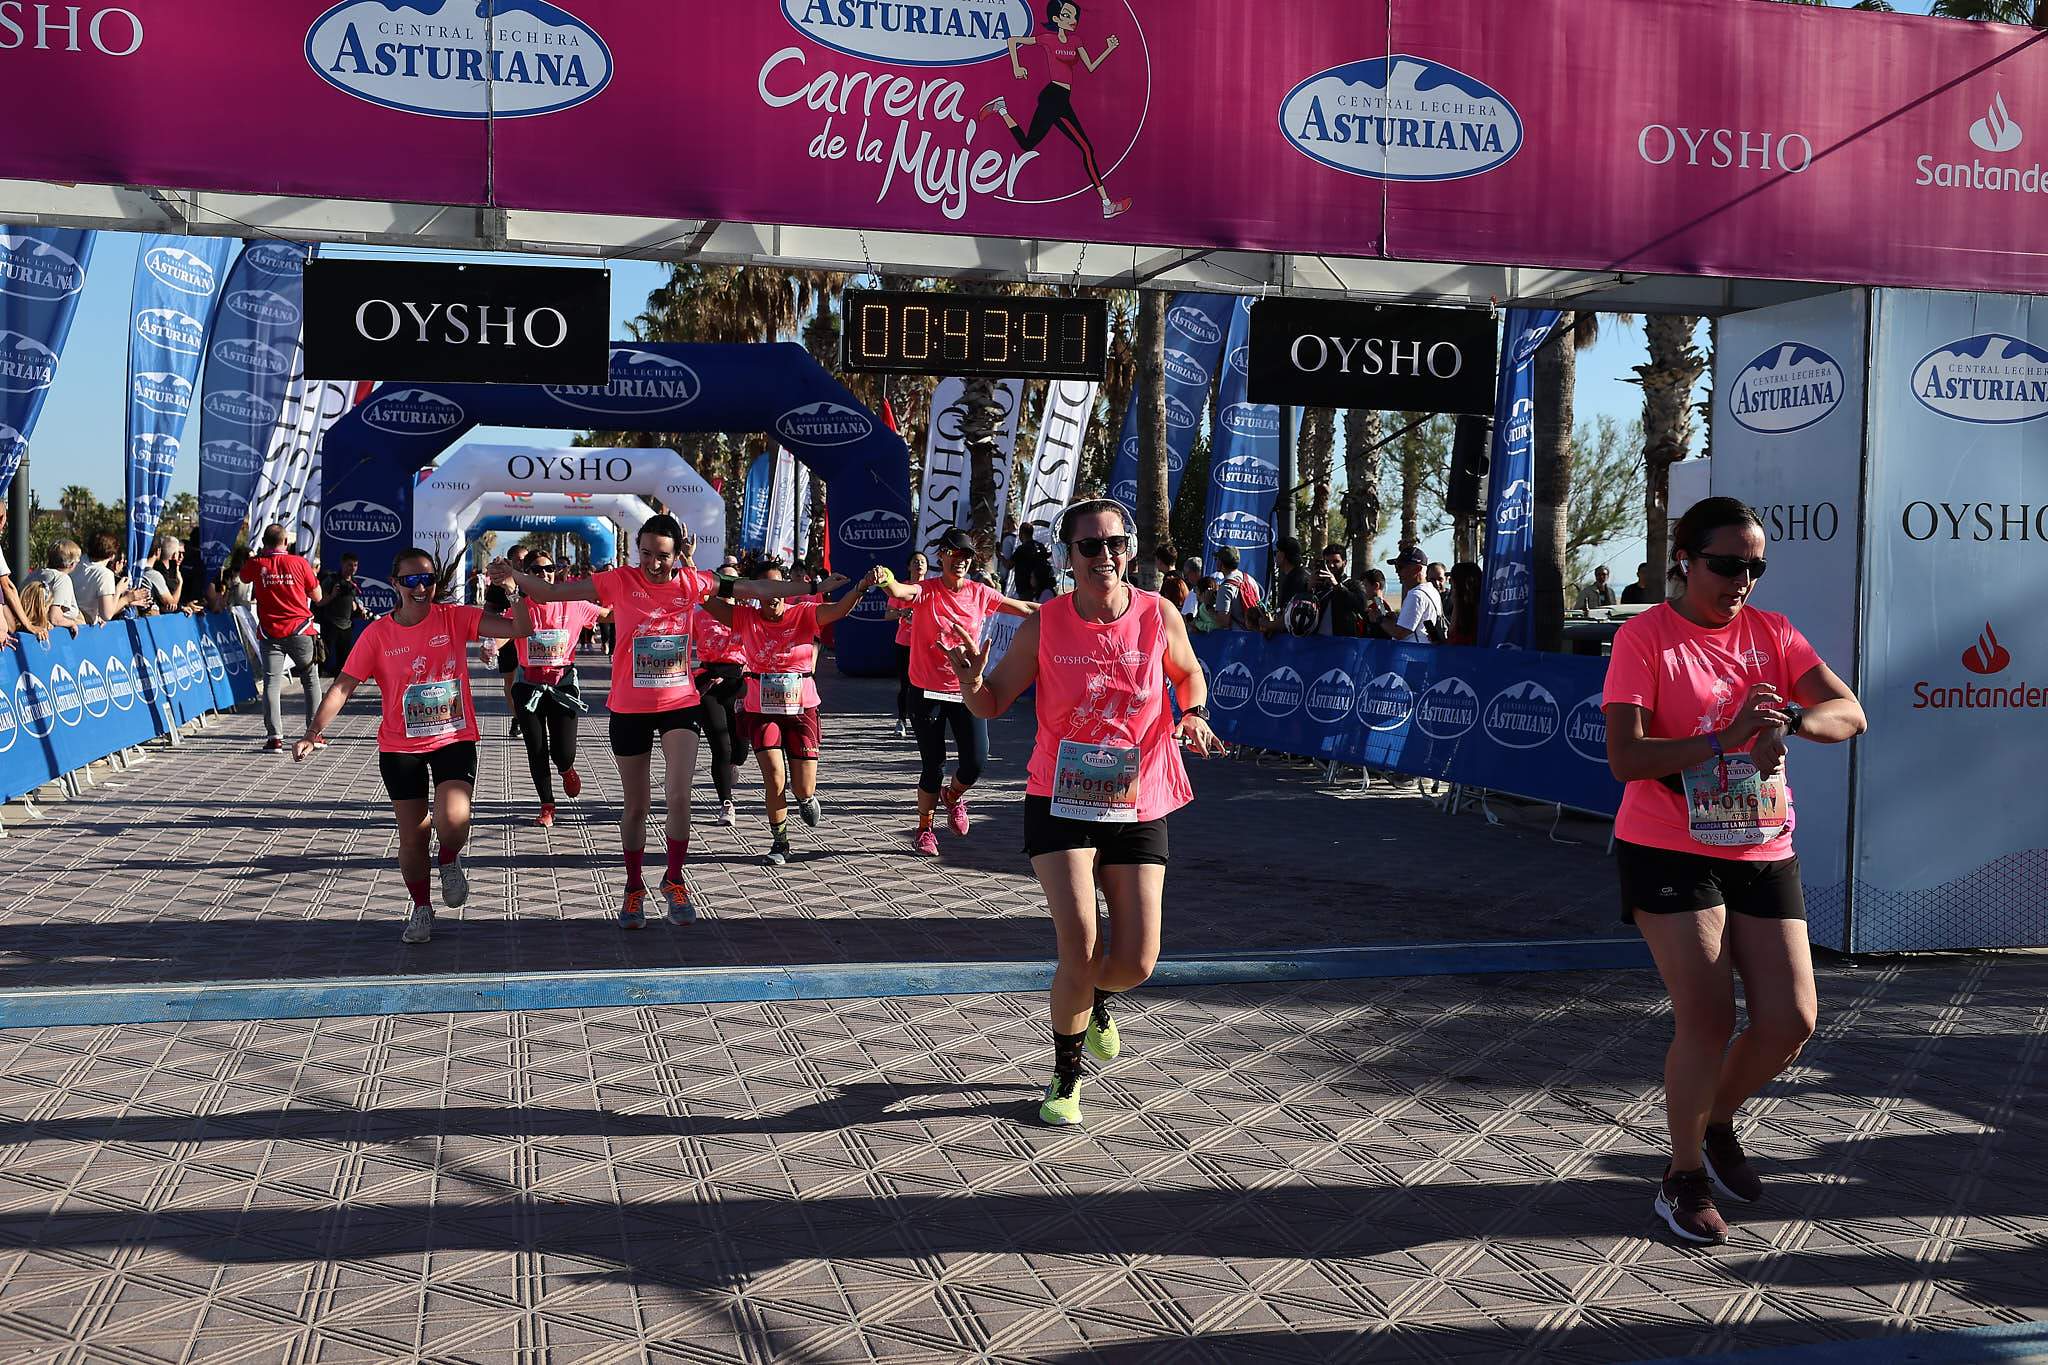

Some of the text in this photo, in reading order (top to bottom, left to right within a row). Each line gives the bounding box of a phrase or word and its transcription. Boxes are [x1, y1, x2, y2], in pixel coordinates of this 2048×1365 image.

[378, 21, 474, 40] CENTRAL
[801, 0, 1012, 40] ASTURIANA
[330, 22, 590, 88] ASTURIANA
[758, 47, 964, 122] Carrera
[1337, 94, 1497, 117] CENTRAL LECHERA
[1298, 95, 1504, 153] ASTURIANA
[1638, 124, 1813, 174] OYSHO
[808, 117, 1040, 220] de la Mujer
[231, 296, 294, 321] ASTURIANA
[355, 299, 568, 348] OYSHO
[863, 304, 1087, 362] 00:43:41
[1290, 334, 1463, 379] OYSHO
[1753, 368, 1833, 386] CENTRAL LECHERA
[1948, 364, 2001, 374] CENTRAL
[1922, 365, 2048, 402] ASTURIAN
[1736, 381, 1835, 414] ASTURIANA
[368, 405, 456, 425] ASTURIANA
[784, 419, 867, 436] ASTURIANA
[507, 455, 632, 482] OYSHO
[431, 482, 470, 490] OYSHO
[667, 485, 703, 494] OYSHO
[326, 515, 396, 533] ASTURIANA
[843, 524, 908, 541] ASTURIANA
[415, 532, 450, 541] OYSHO
[1054, 655, 1090, 664] OYSHO
[1214, 679, 1249, 699] ASTURIANA
[1258, 684, 1298, 706] ASTURIANA
[1308, 688, 1350, 711] ASTURIANA
[1360, 693, 1408, 717] ASTURIANA
[1419, 699, 1472, 725] ASTURIANA
[1488, 703, 1552, 734] ASTURIANA
[1083, 778, 1114, 793] 016
[1722, 794, 1758, 809] 016
[1701, 833, 1734, 841] OYSHO
